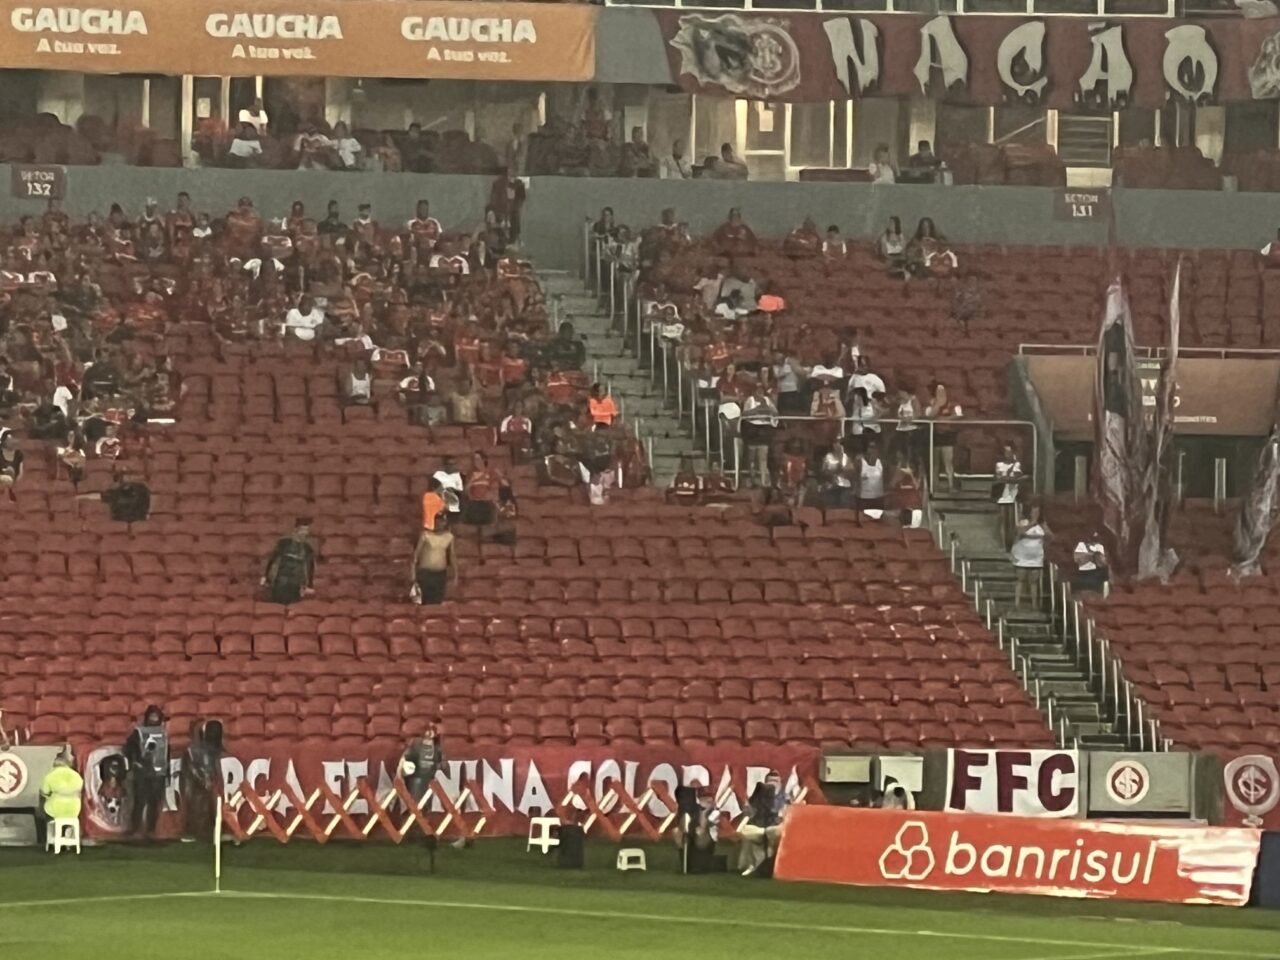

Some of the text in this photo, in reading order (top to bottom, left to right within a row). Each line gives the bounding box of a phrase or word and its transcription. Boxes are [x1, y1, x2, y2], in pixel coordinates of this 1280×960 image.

[36, 38, 52, 53] A
[231, 44, 247, 59] A
[426, 47, 442, 62] A
[952, 750, 1076, 813] FFC
[945, 830, 1157, 885] banrisul
